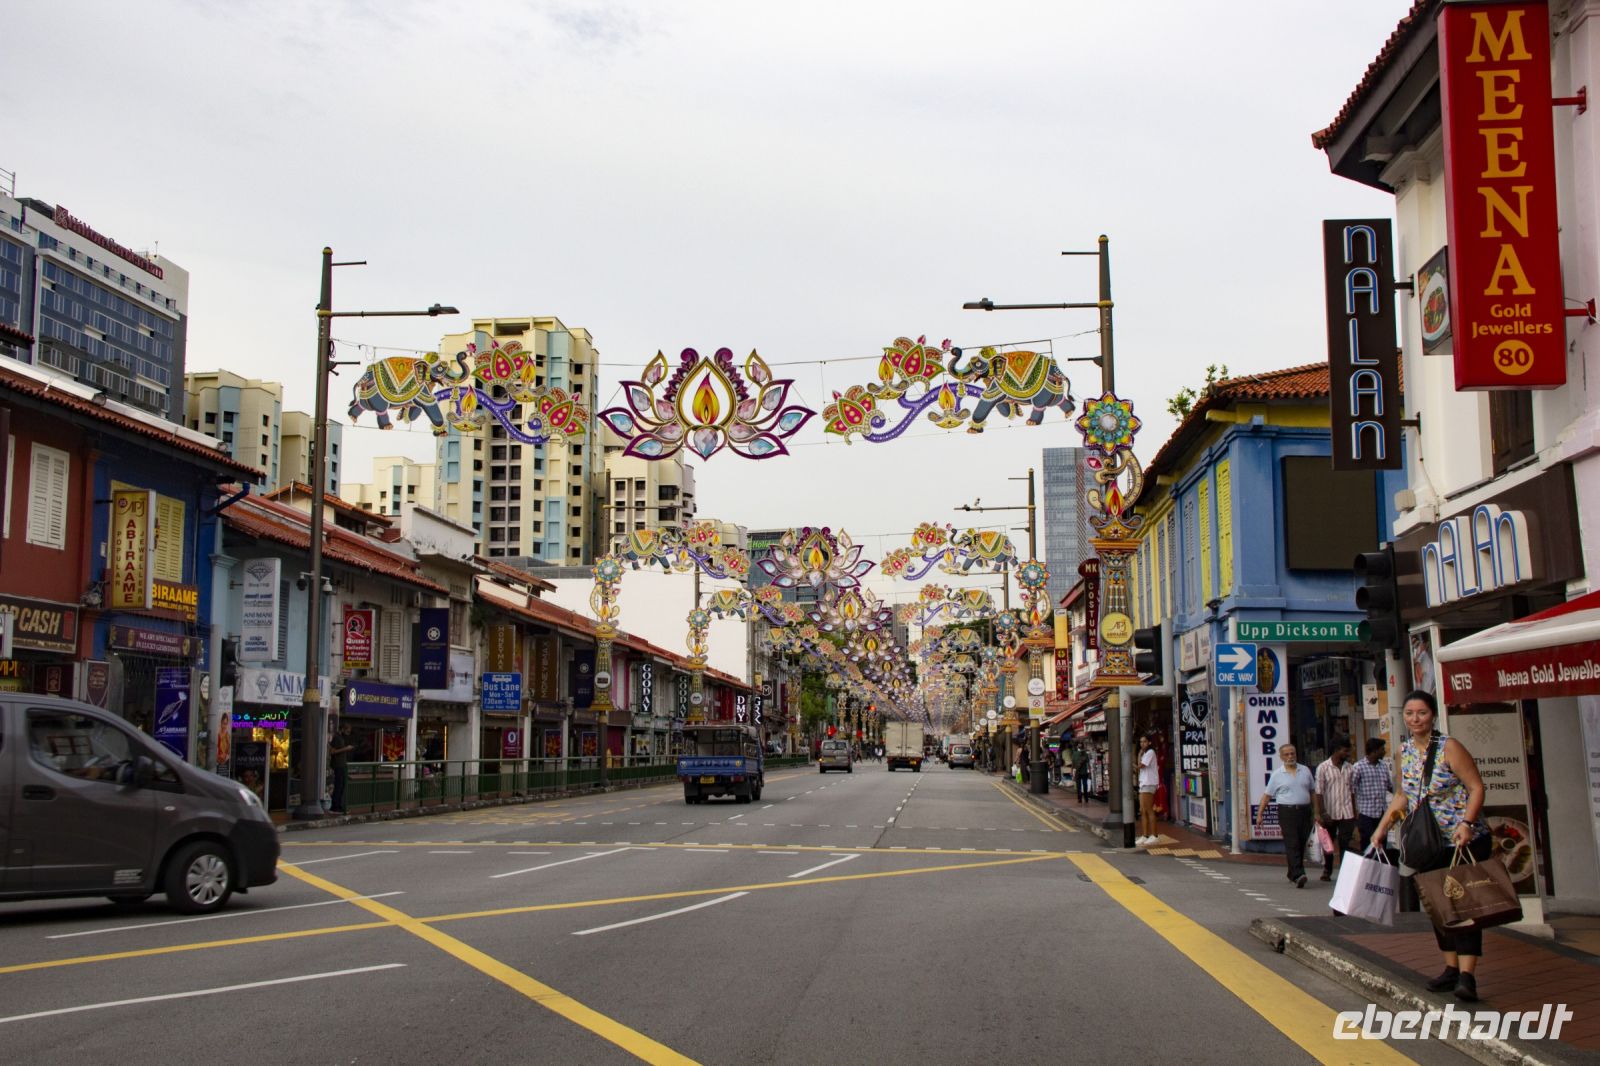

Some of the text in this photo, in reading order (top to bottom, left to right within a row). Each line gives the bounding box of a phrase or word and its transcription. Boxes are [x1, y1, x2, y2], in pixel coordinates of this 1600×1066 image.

[1465, 10, 1536, 297] MEENA
[1490, 303, 1532, 318] Gold
[1472, 320, 1553, 339] Jewellers
[1498, 348, 1529, 367] 80
[123, 519, 136, 603] ABIRAAME
[152, 583, 198, 606] BIRAAME
[19, 607, 62, 635] CASH
[1087, 582, 1097, 646] COSTUME
[1240, 624, 1270, 639] Upp
[1276, 621, 1338, 637] Dickson
[274, 673, 324, 697] ANI MI
[484, 681, 520, 691] Bus Lane
[642, 663, 652, 713] GOODAY
[1218, 673, 1254, 682] ONE WAY
[1389, 675, 1396, 687] 4
[1451, 672, 1472, 690] NETS
[1497, 670, 1529, 688] Meena
[1531, 664, 1555, 684] Gold
[679, 676, 688, 718] GOODAY
[1249, 697, 1285, 707] OHMS
[736, 696, 746, 722] DMY
[1488, 756, 1520, 764] INDIAN
